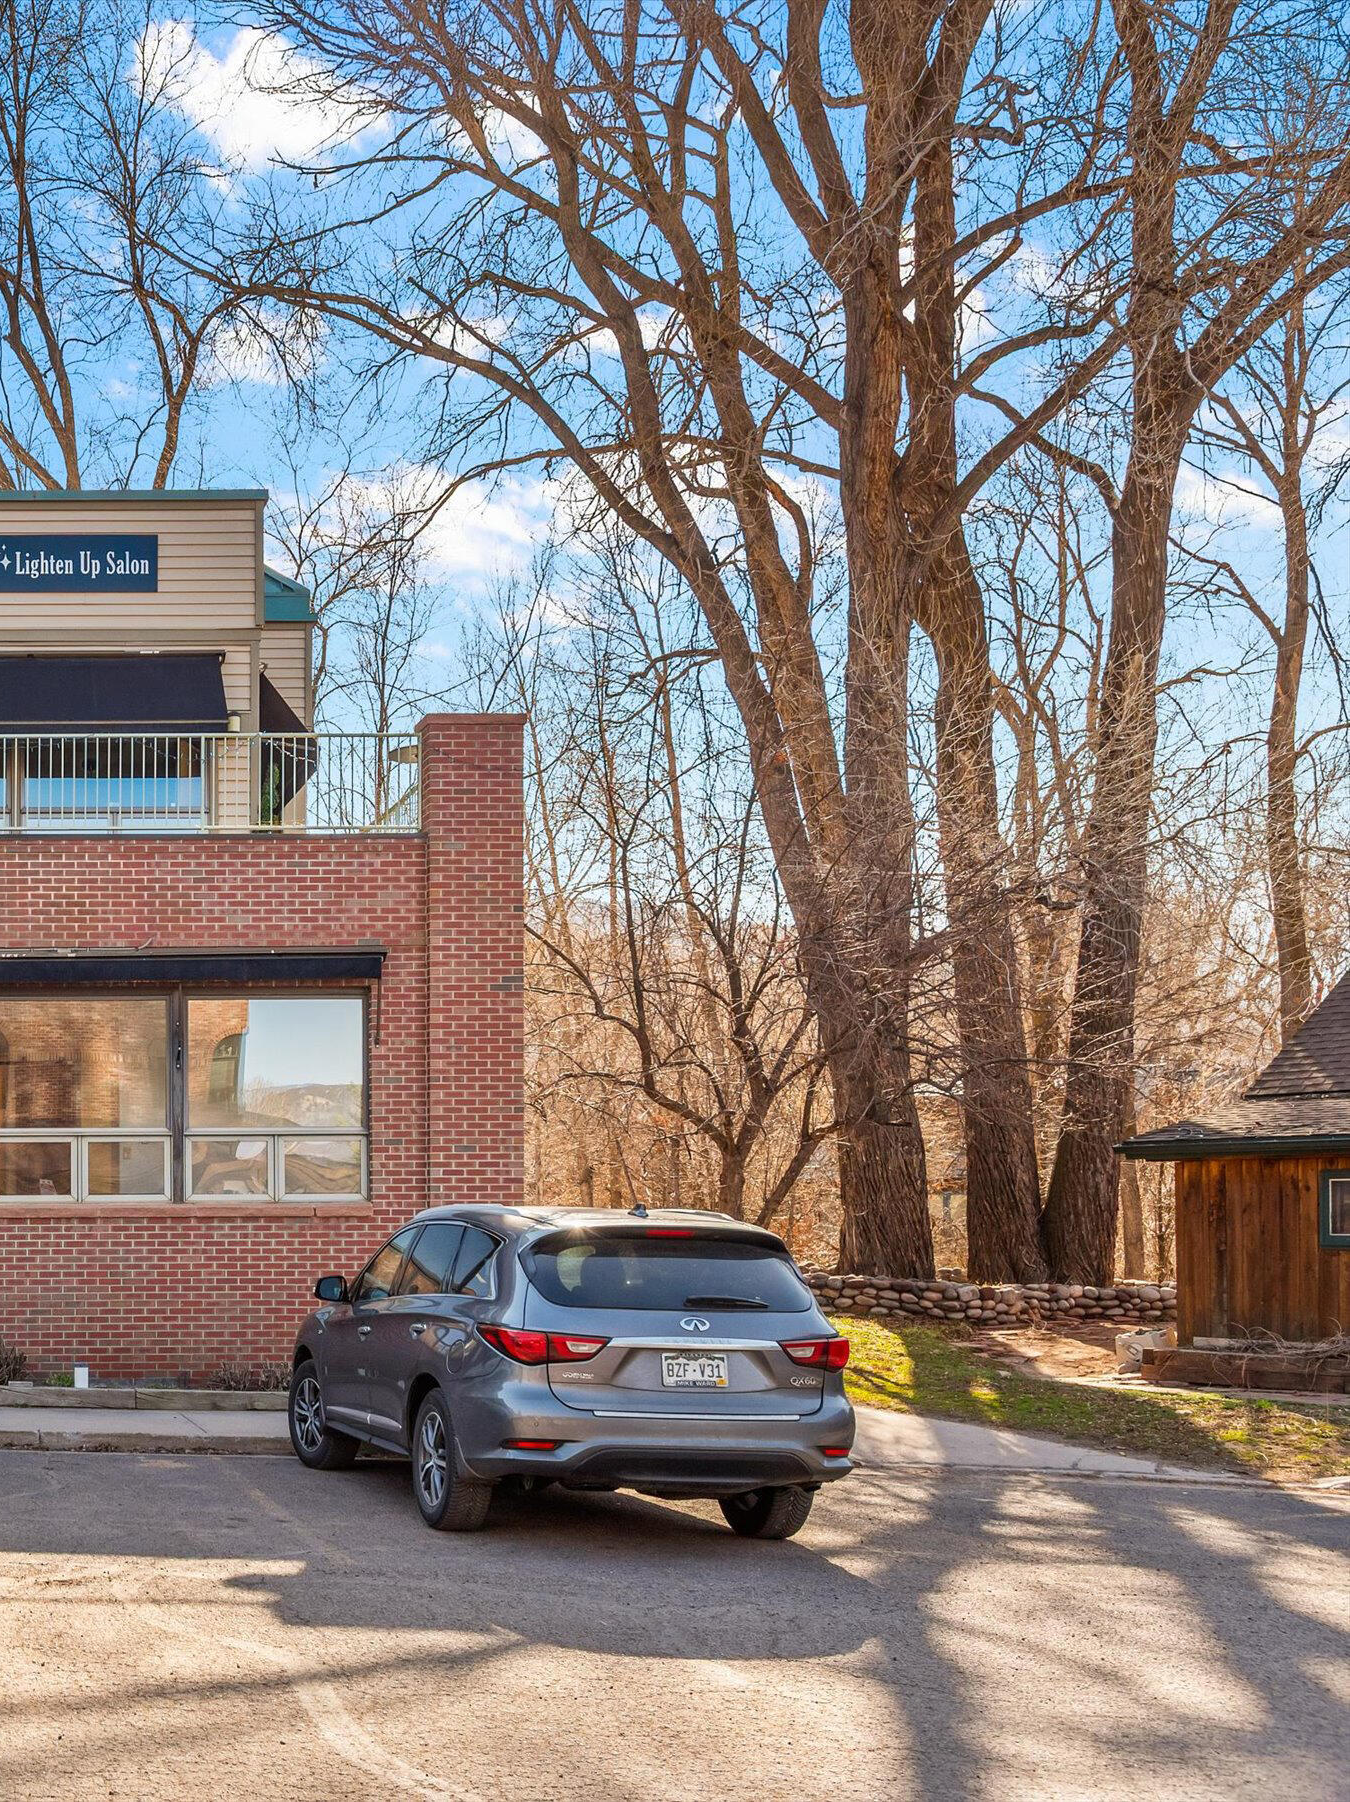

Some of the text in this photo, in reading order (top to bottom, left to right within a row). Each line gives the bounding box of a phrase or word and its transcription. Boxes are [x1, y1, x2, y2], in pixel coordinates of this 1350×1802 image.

[15, 551, 150, 579] Lighten Up Salon
